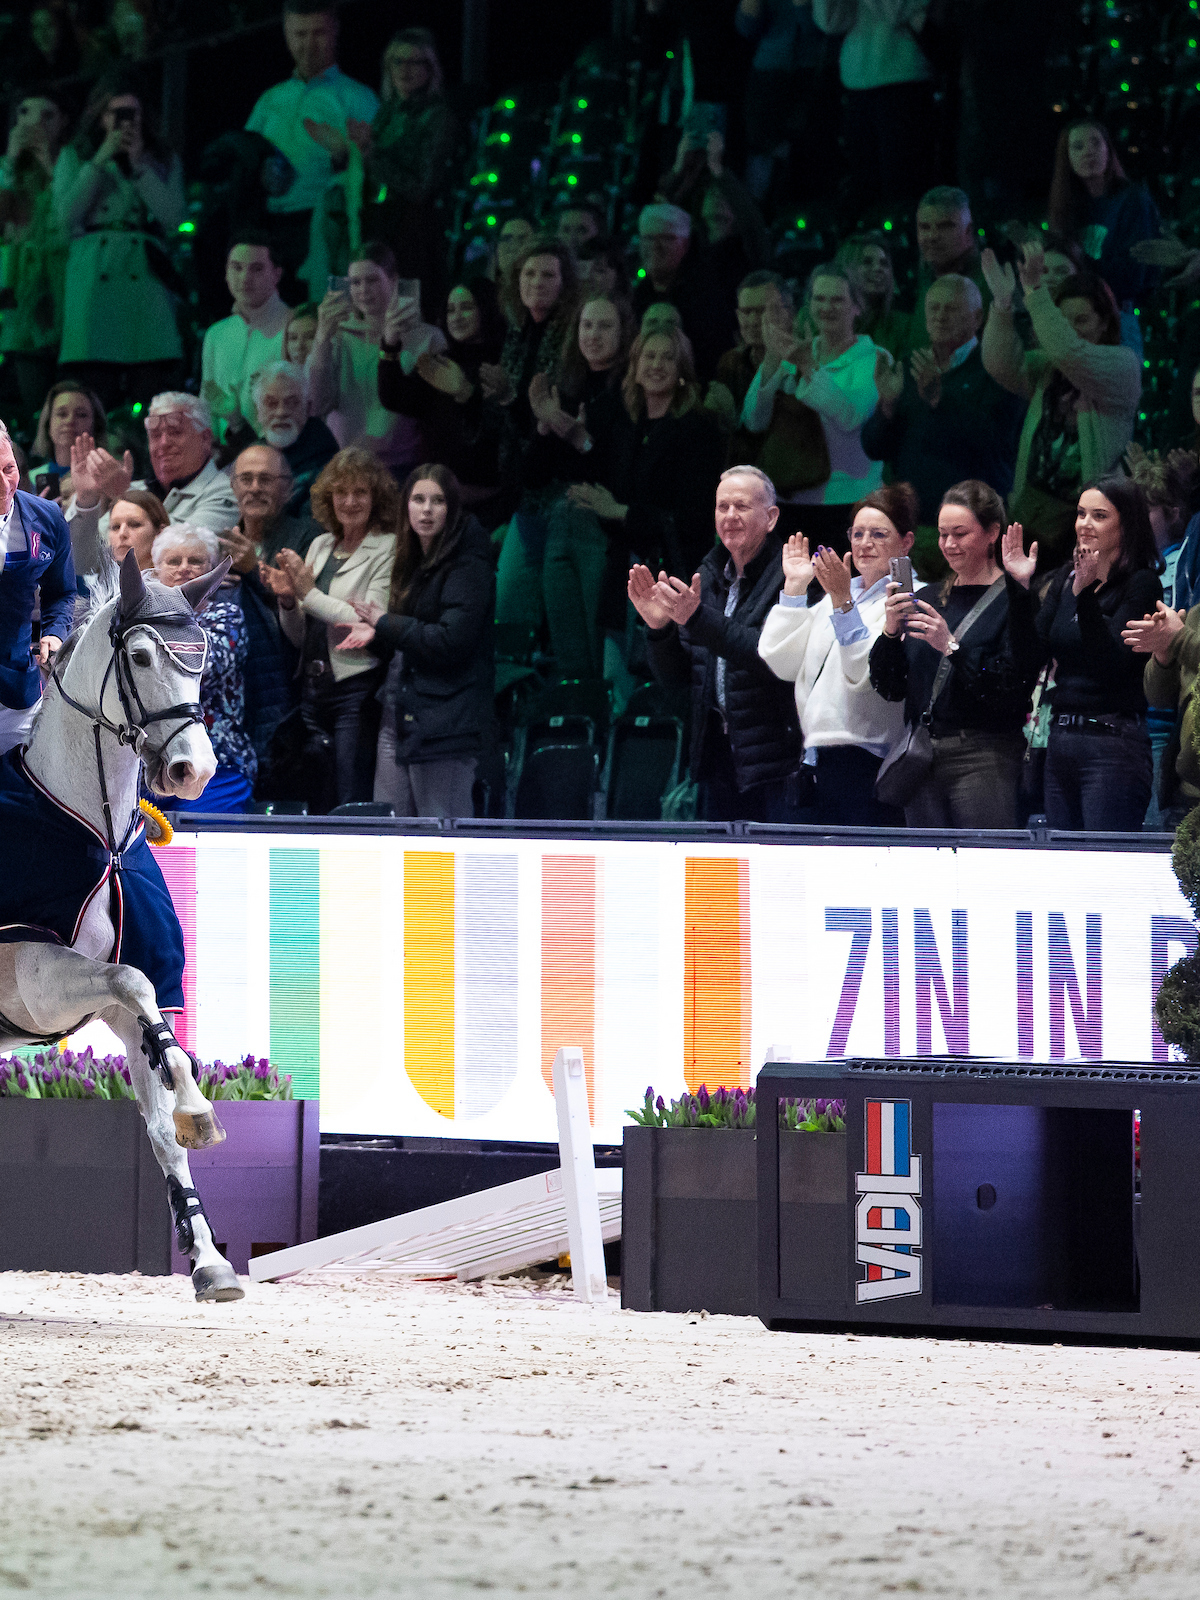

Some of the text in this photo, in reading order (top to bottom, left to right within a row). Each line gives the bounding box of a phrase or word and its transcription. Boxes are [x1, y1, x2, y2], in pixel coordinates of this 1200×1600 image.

[824, 906, 970, 1057] ZIN
[1016, 910, 1103, 1060] IN
[855, 1153, 922, 1305] VDL
